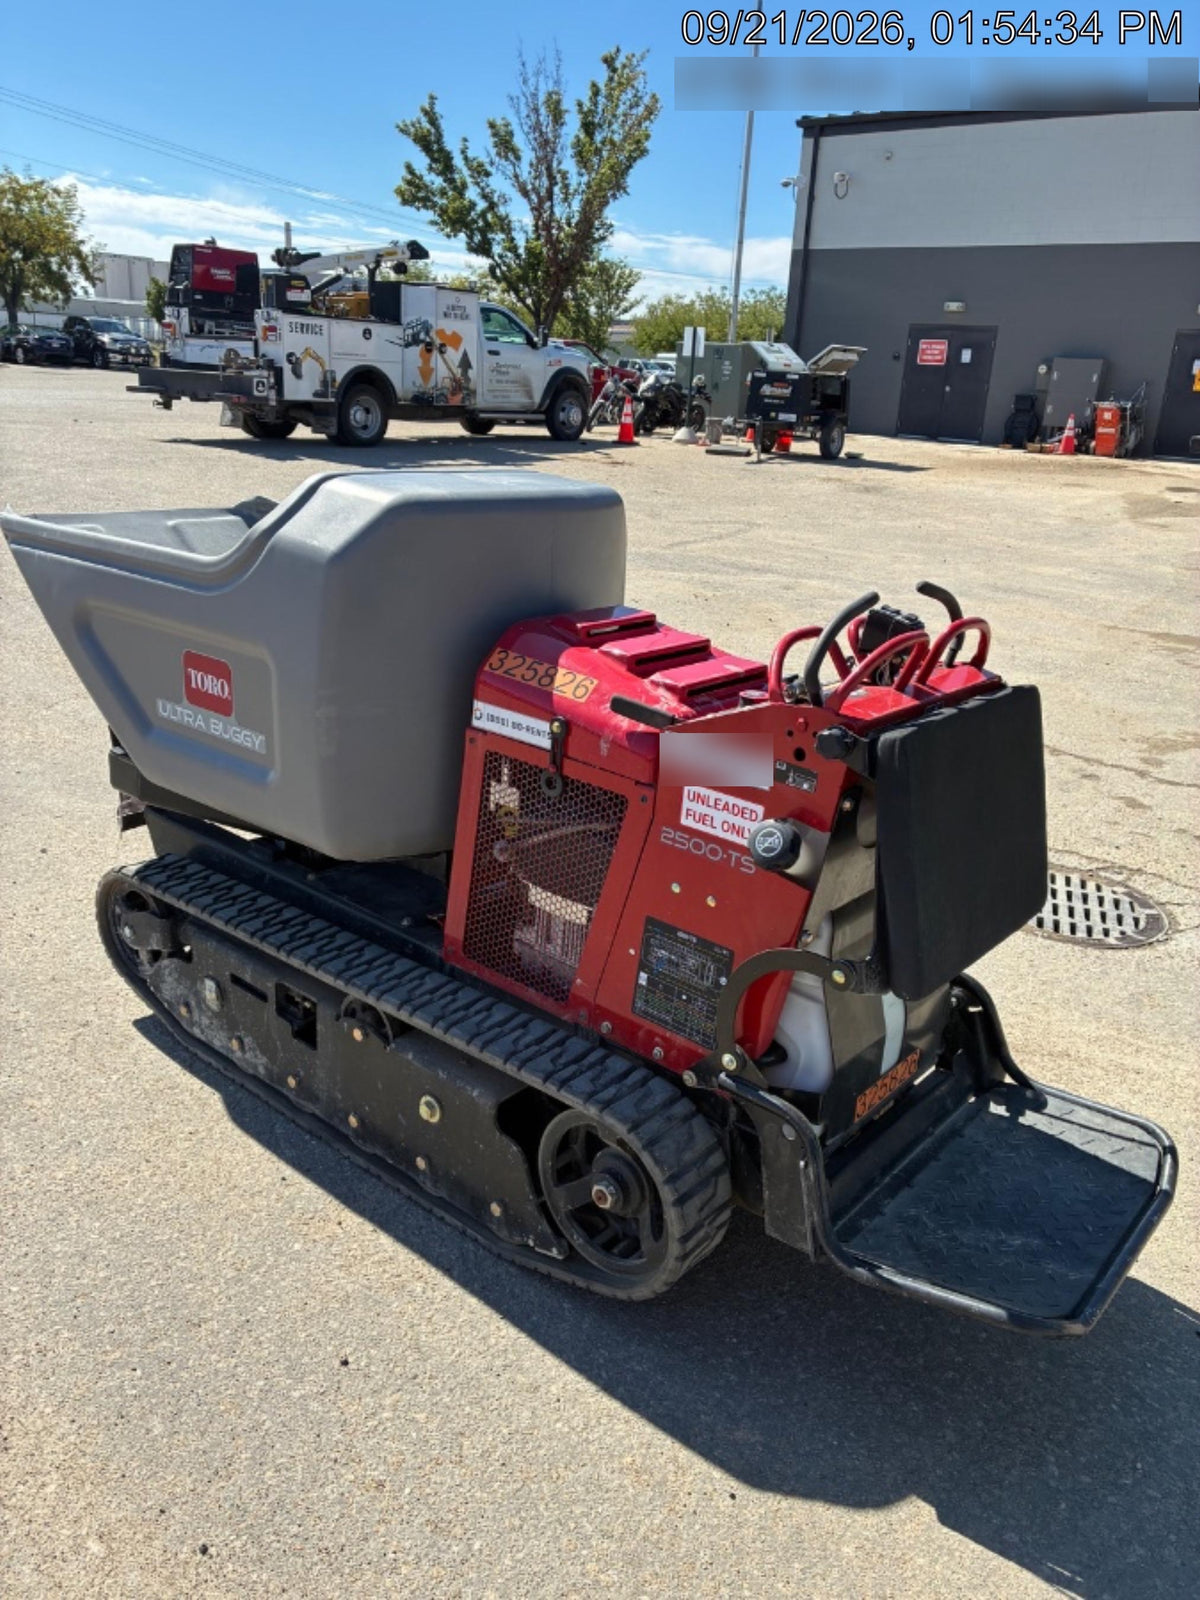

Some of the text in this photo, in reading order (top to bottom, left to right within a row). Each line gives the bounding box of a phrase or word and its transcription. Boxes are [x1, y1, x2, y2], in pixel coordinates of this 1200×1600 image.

[288, 321, 323, 336] SERVICE
[187, 667, 230, 700] TORO
[488, 650, 595, 700] 325826
[156, 698, 266, 754] ULTRA BUGGY
[685, 808, 717, 830] FUEL
[687, 789, 758, 823] UNLEADED
